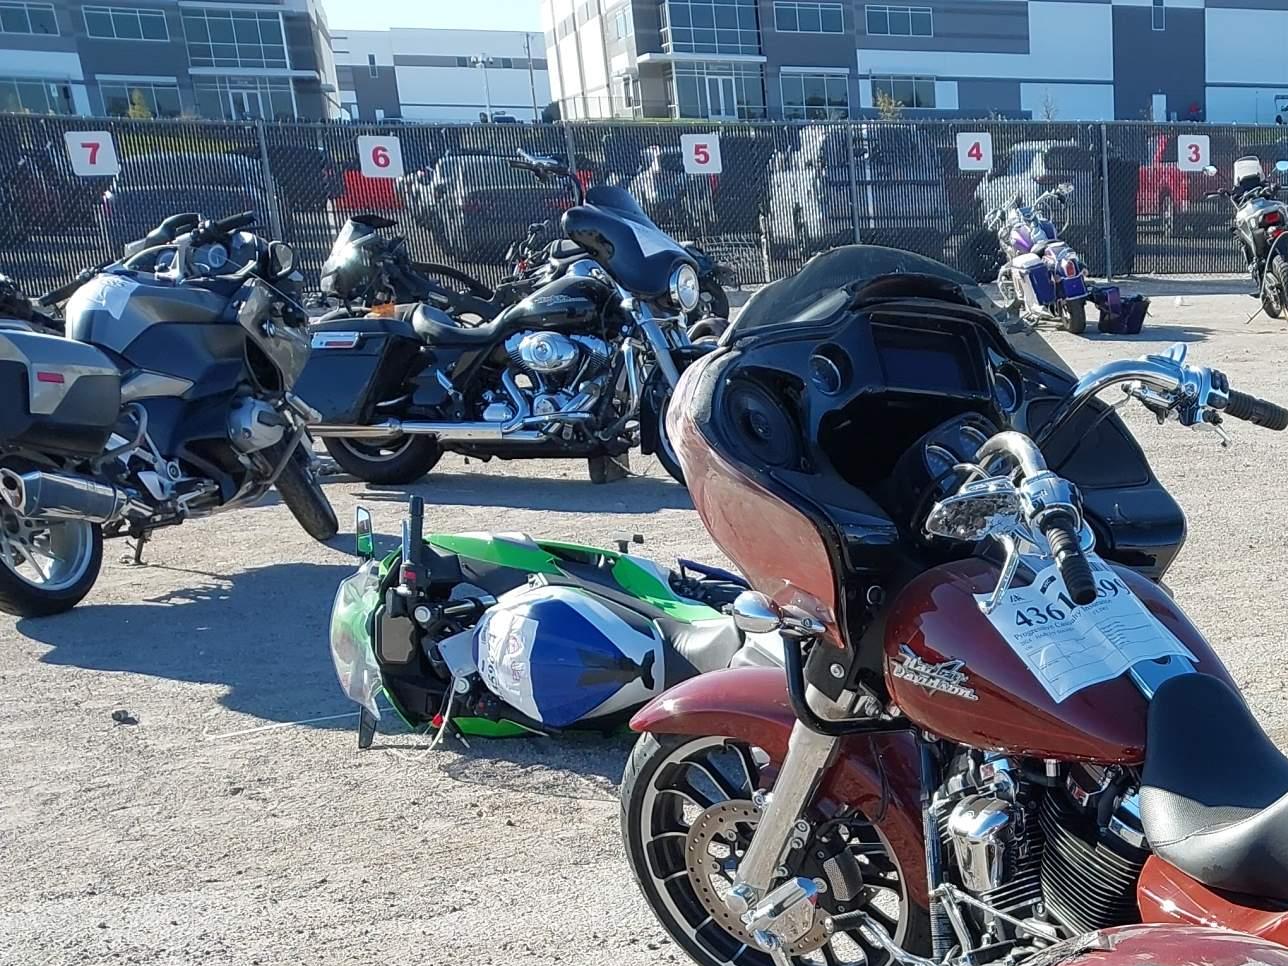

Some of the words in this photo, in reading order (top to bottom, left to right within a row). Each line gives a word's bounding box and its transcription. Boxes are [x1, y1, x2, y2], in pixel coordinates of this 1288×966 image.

[81, 142, 100, 165] 7
[372, 146, 390, 168] 6
[694, 143, 710, 165] 5
[967, 141, 983, 161] 4
[1187, 143, 1201, 163] 3
